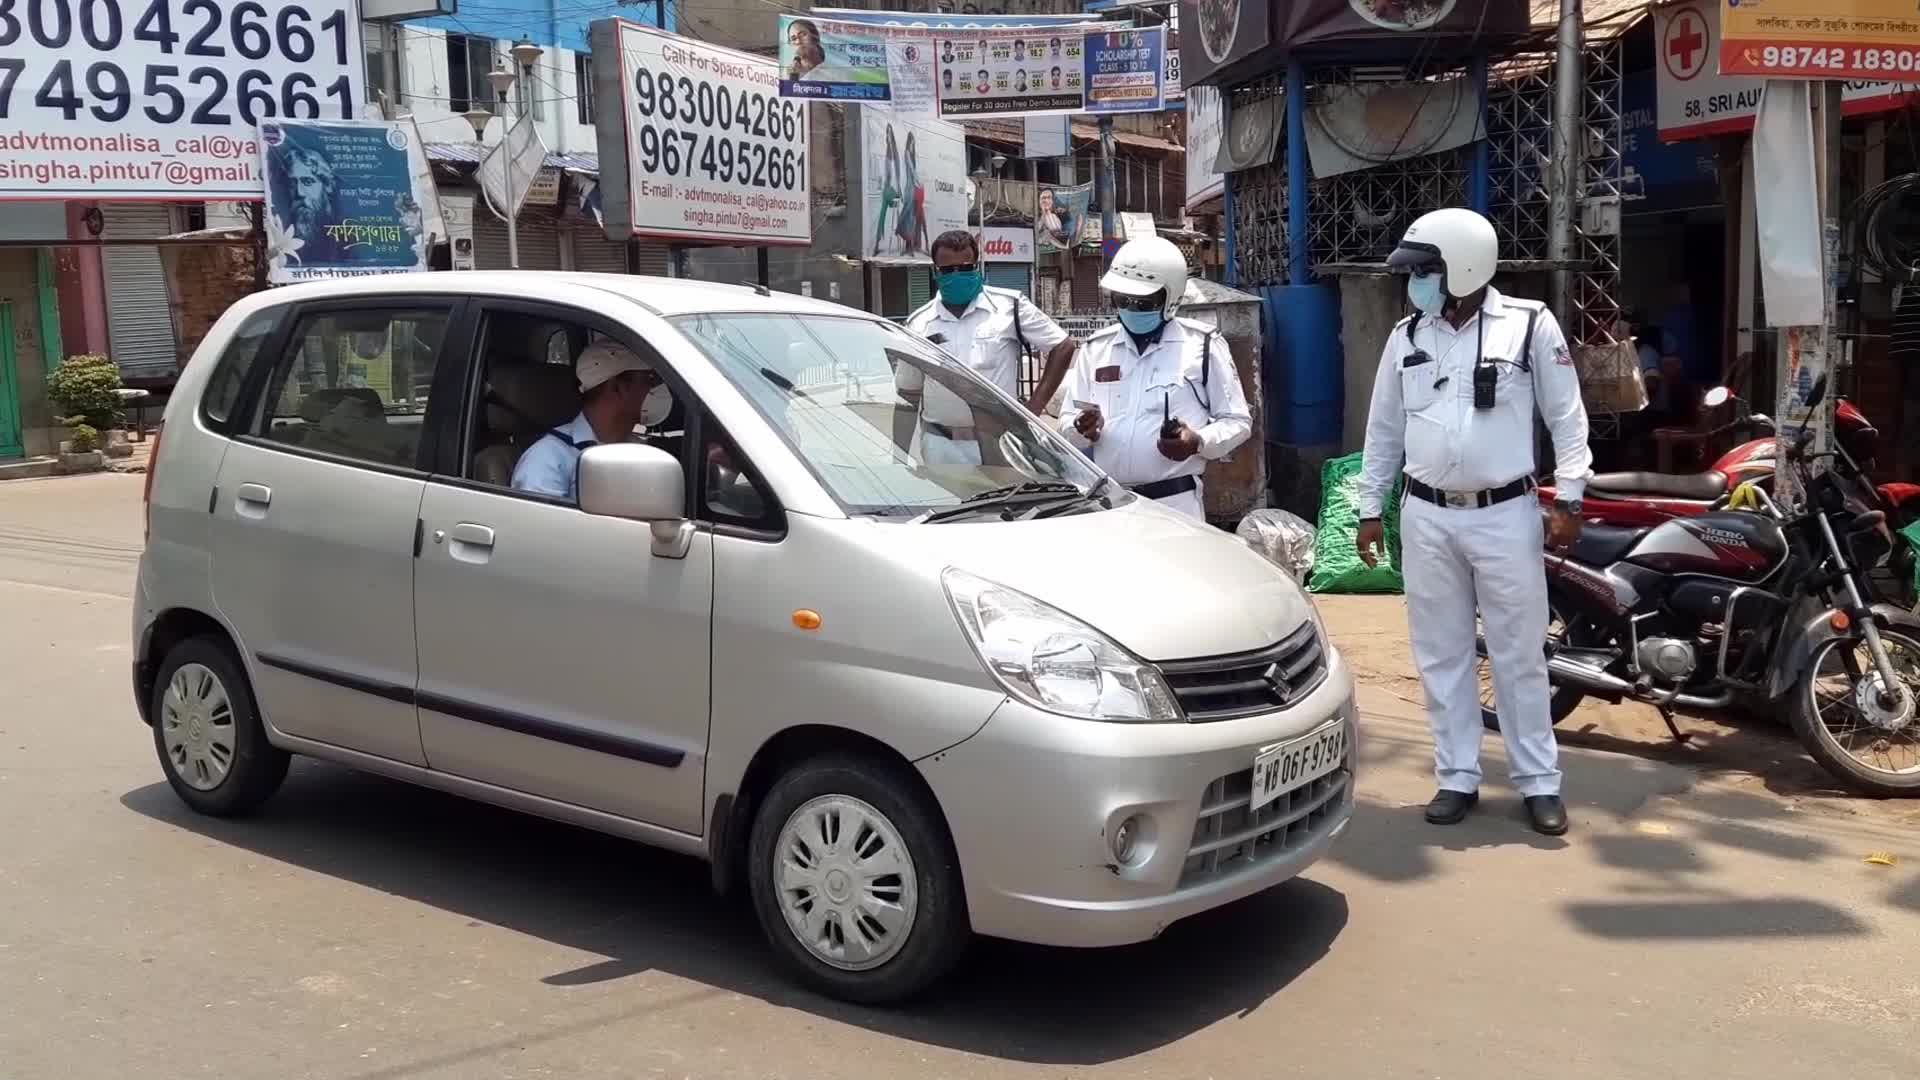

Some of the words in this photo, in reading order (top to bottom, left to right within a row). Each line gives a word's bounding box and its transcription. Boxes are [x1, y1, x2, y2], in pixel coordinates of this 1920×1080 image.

[1066, 48, 1080, 56] 654
[1096, 49, 1137, 62] SCHOLARSHIP
[1138, 48, 1151, 60] TEST
[1763, 46, 1845, 69] 98742
[662, 44, 686, 65] Call
[689, 51, 710, 70] For
[712, 57, 744, 80] Space
[746, 66, 779, 88] Contac
[1099, 63, 1118, 72] CLASS
[635, 68, 805, 144] 9830042661
[943, 103, 971, 112] Register
[971, 102, 983, 110] For
[994, 100, 1011, 109] days
[1028, 99, 1050, 107] Demo
[1051, 98, 1080, 106] Sessions
[1685, 99, 1705, 118] 58,
[1709, 93, 1732, 113] SRI
[1736, 87, 1761, 109] AU
[640, 125, 805, 192] 9674952661
[642, 180, 673, 199] E-mail
[685, 188, 805, 212] advtmonalisa_cal@yahoo.co.in
[683, 208, 788, 229] singha.pintu7@gmail.com
[975, 232, 1014, 255] ata
[1058, 321, 1089, 329] HOWRAH
[1089, 320, 1105, 329] CITY
[1700, 533, 1749, 548] HONDA
[1703, 526, 1745, 540] HERO
